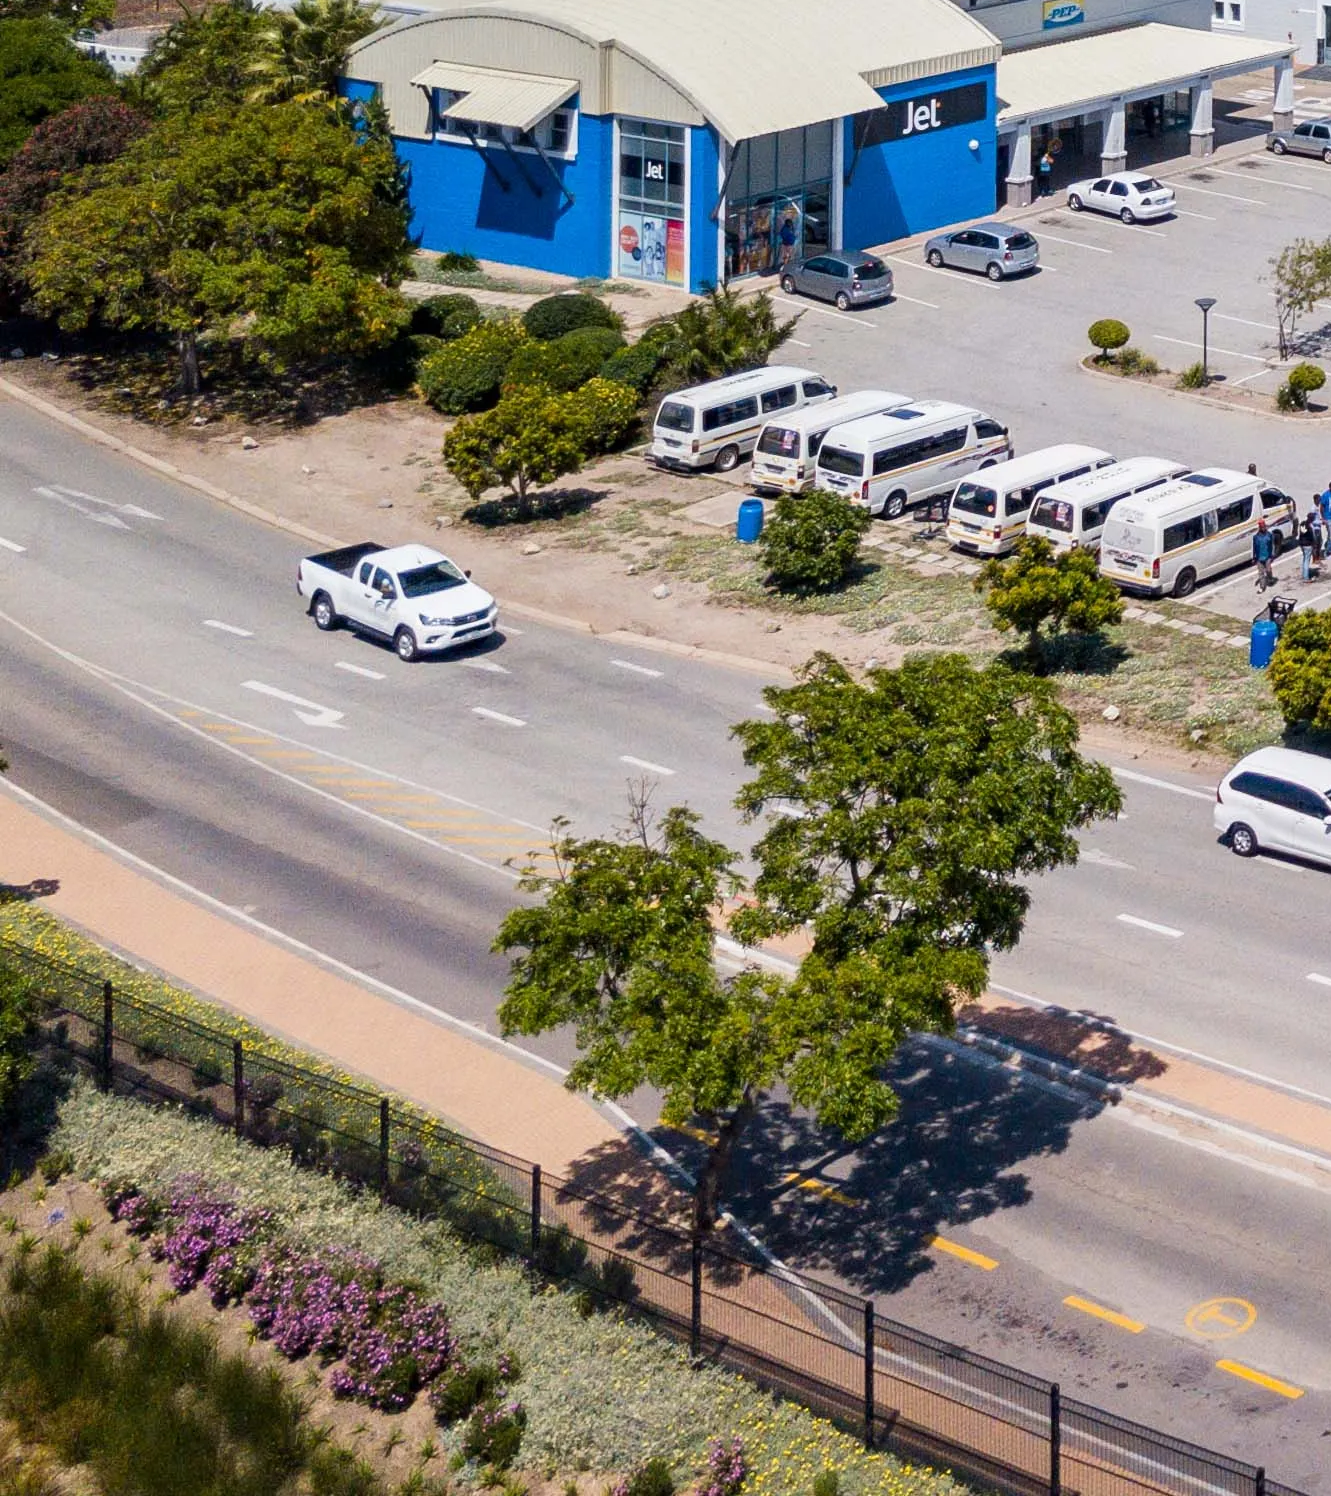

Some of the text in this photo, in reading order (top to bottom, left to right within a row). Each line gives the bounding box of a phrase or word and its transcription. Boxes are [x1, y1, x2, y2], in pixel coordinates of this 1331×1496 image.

[1051, 5, 1076, 20] PEP
[902, 98, 941, 135] Jet
[645, 161, 664, 180] Jet
